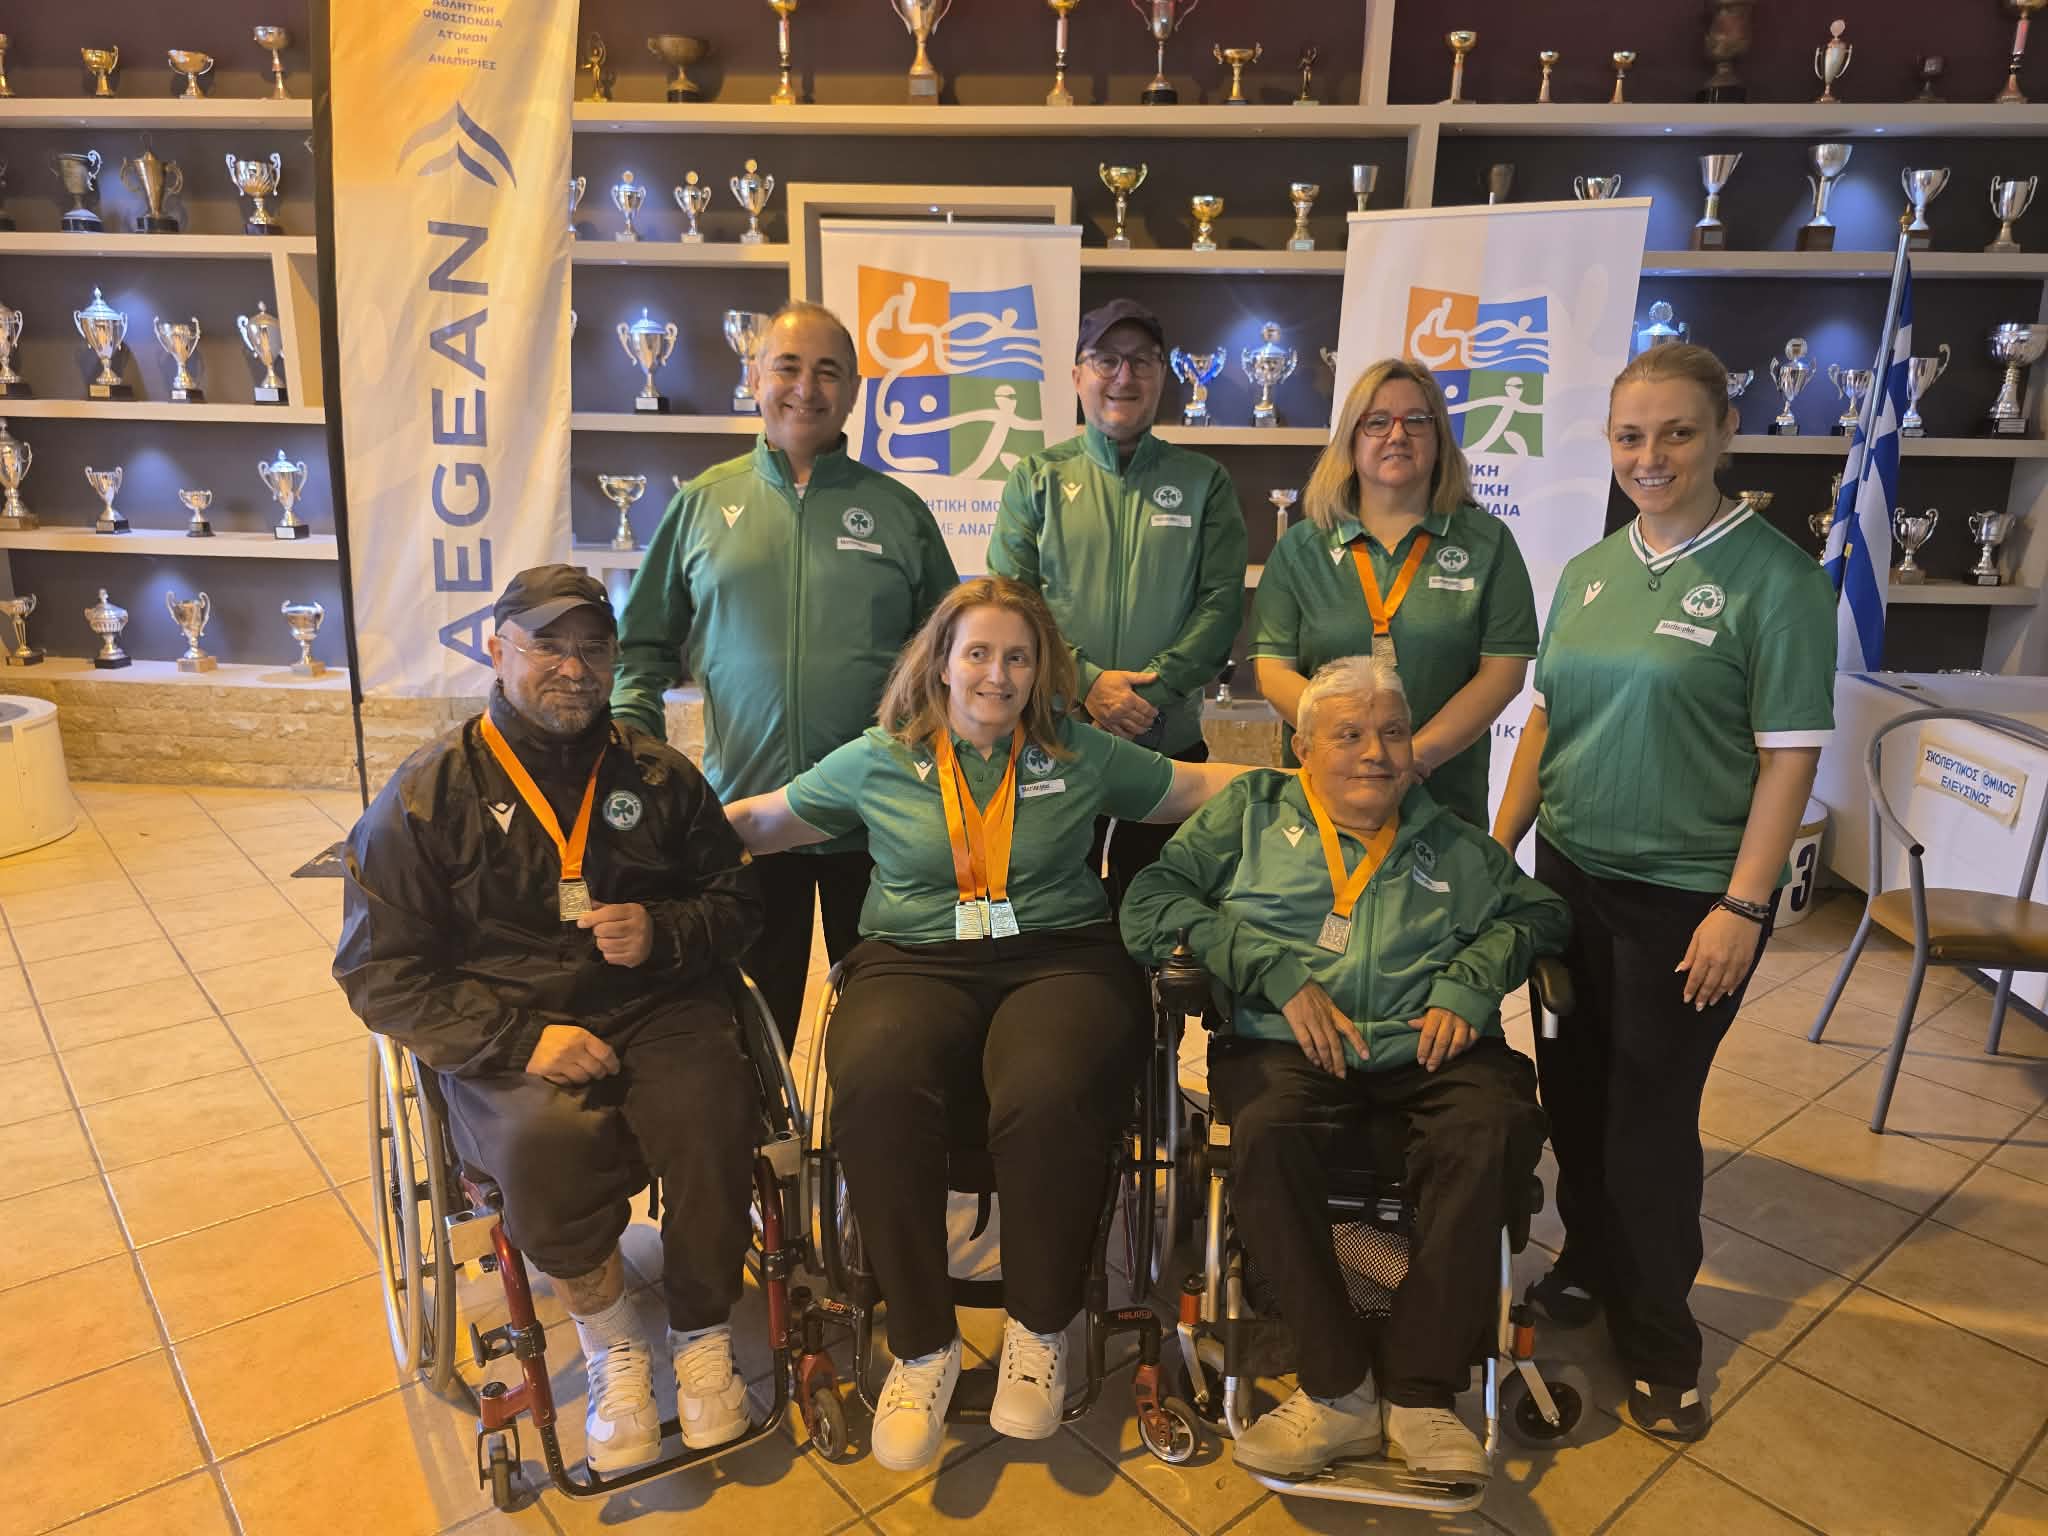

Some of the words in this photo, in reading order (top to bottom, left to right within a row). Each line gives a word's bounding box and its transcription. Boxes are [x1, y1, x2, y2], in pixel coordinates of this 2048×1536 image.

[438, 30, 487, 43] ΑΤΟΜΩΝ
[428, 53, 496, 70] ΑΝΑΠΗΡΙΕΣ
[428, 221, 495, 669] AEGEAN
[1925, 750, 1980, 782] ΣΚΟΠΕΥΤΙΚΟΣ
[1982, 773, 2017, 798] ΟΜΙΛΟΣ
[1790, 842, 1817, 912] 3
